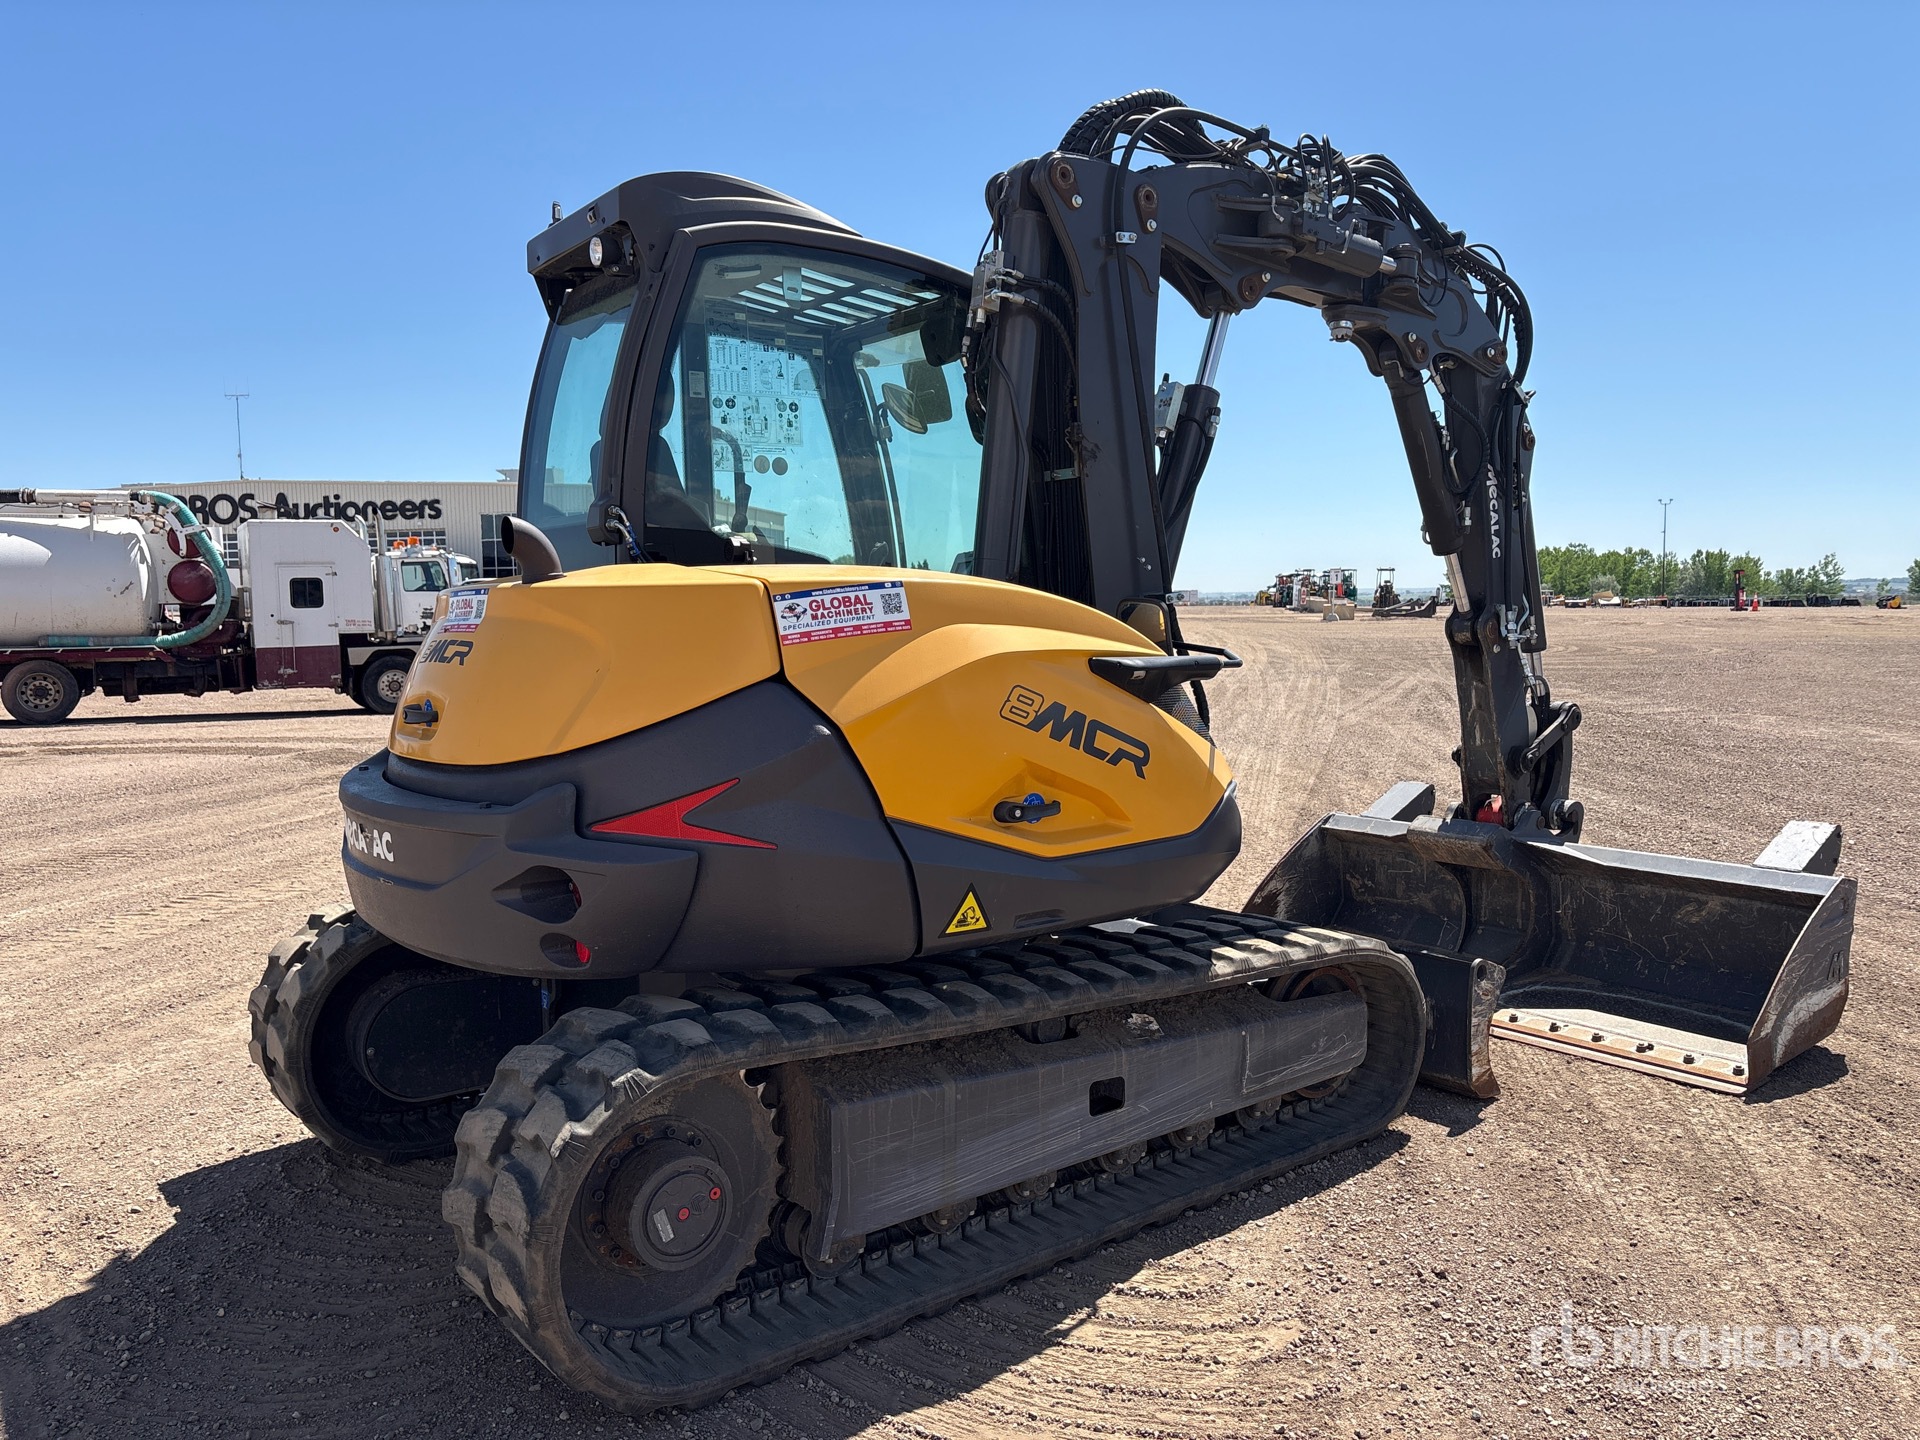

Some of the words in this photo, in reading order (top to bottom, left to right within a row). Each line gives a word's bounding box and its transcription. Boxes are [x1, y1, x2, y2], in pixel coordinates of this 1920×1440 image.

[173, 492, 258, 525] ROS
[275, 492, 442, 523] Auctioneers
[808, 593, 874, 612] GLOBAL
[782, 619, 831, 632] SPECIALIZED
[833, 614, 875, 625] EQUIPMENT
[811, 606, 874, 621] MACHINERY
[1000, 684, 1151, 780] 8MCR
